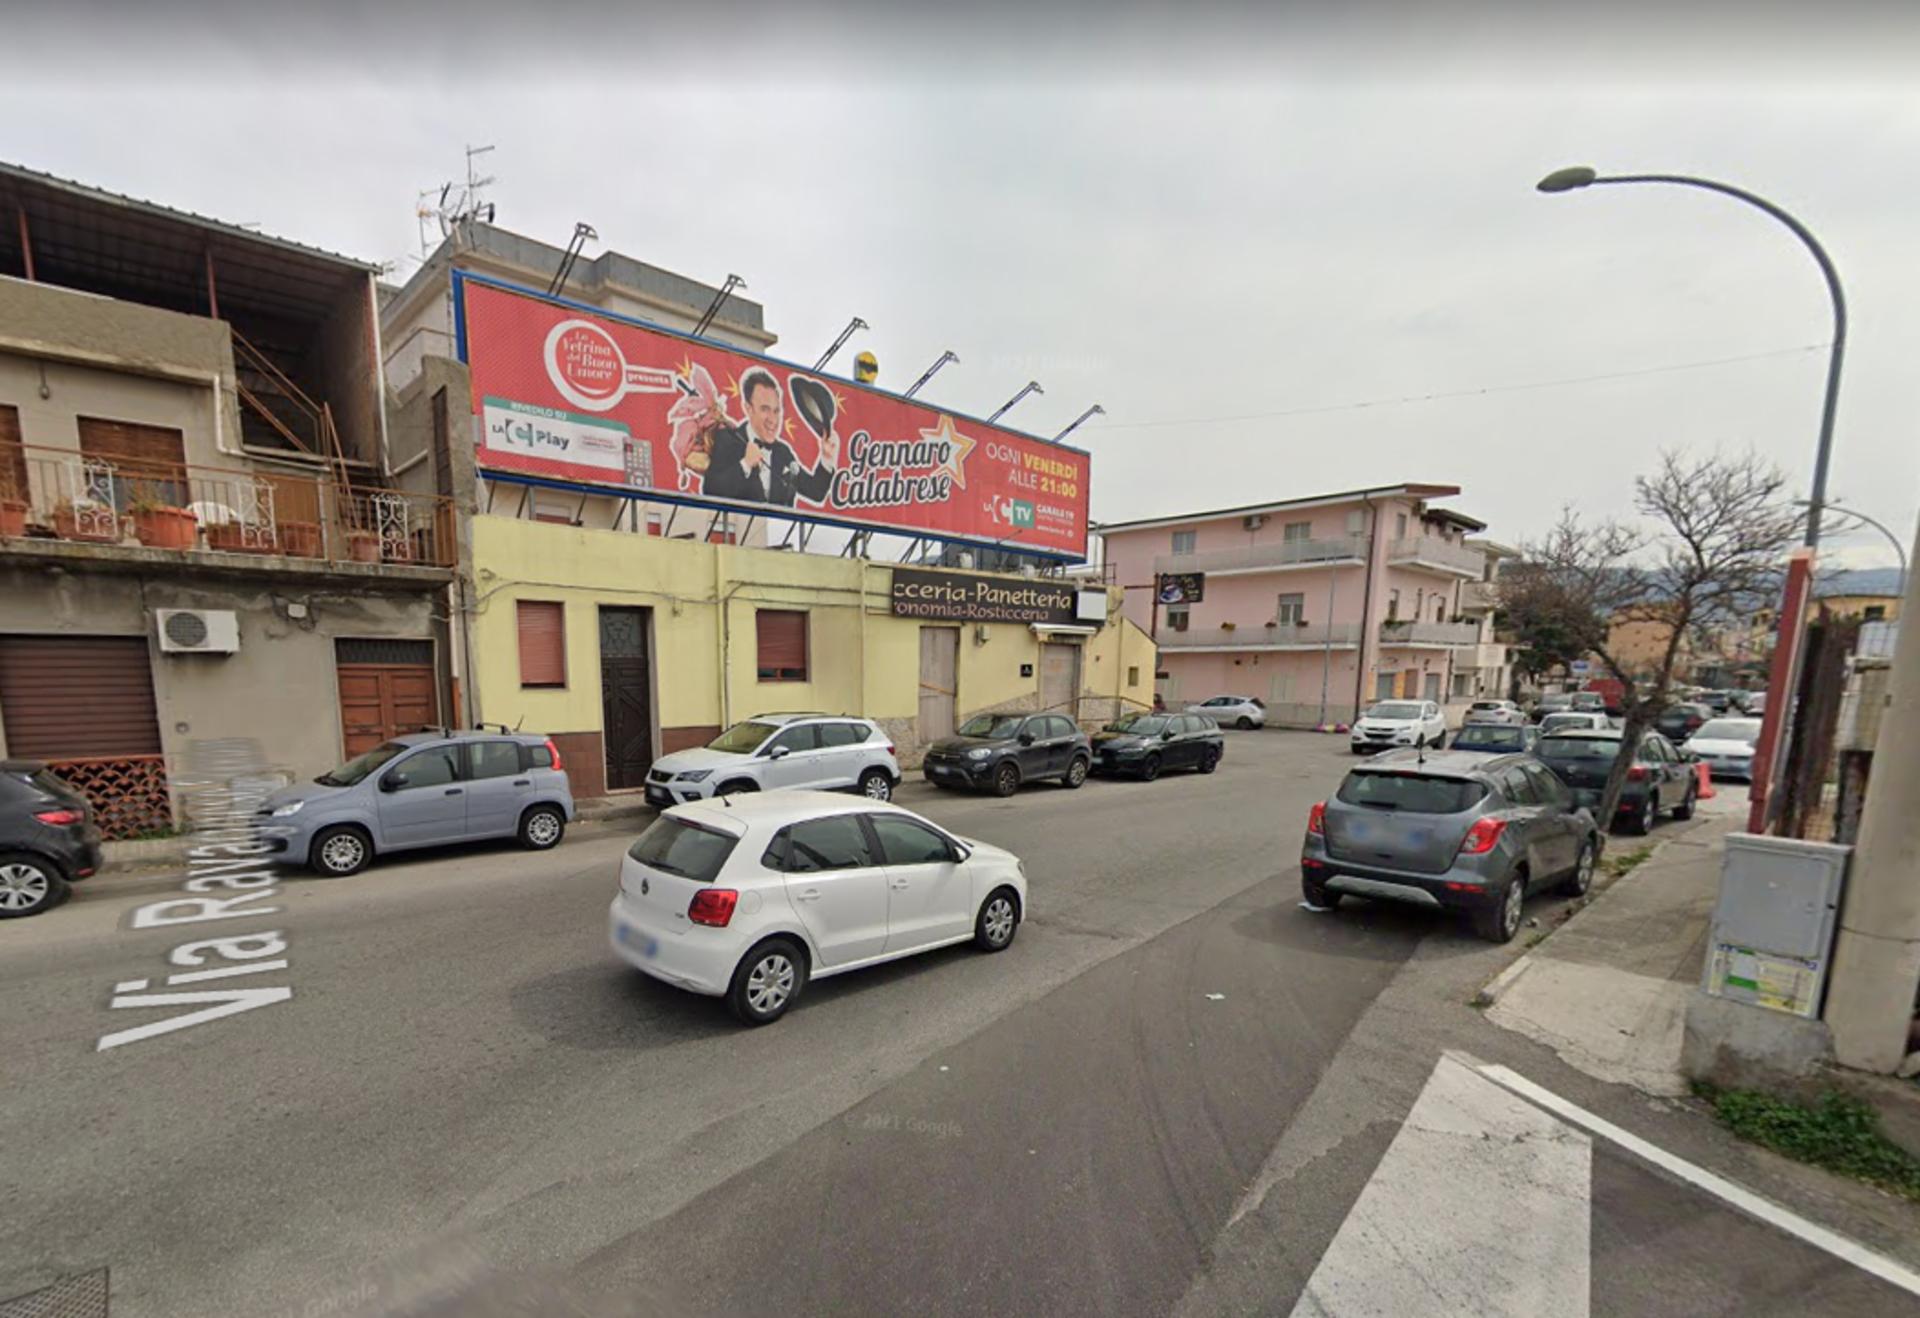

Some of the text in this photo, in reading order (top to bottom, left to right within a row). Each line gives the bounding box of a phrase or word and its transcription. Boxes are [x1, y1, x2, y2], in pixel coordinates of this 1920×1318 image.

[562, 337, 611, 355] Vetrina
[582, 354, 617, 370] Buon
[627, 371, 670, 385] presenta
[536, 430, 570, 450] Play
[850, 431, 950, 477] Gennaro
[985, 442, 1021, 464] OGNI
[832, 469, 950, 507] Calabrese
[1008, 469, 1077, 499] ALLE 21:00
[1015, 505, 1032, 521] TV
[894, 601, 1049, 621] onomia-Rosticceria
